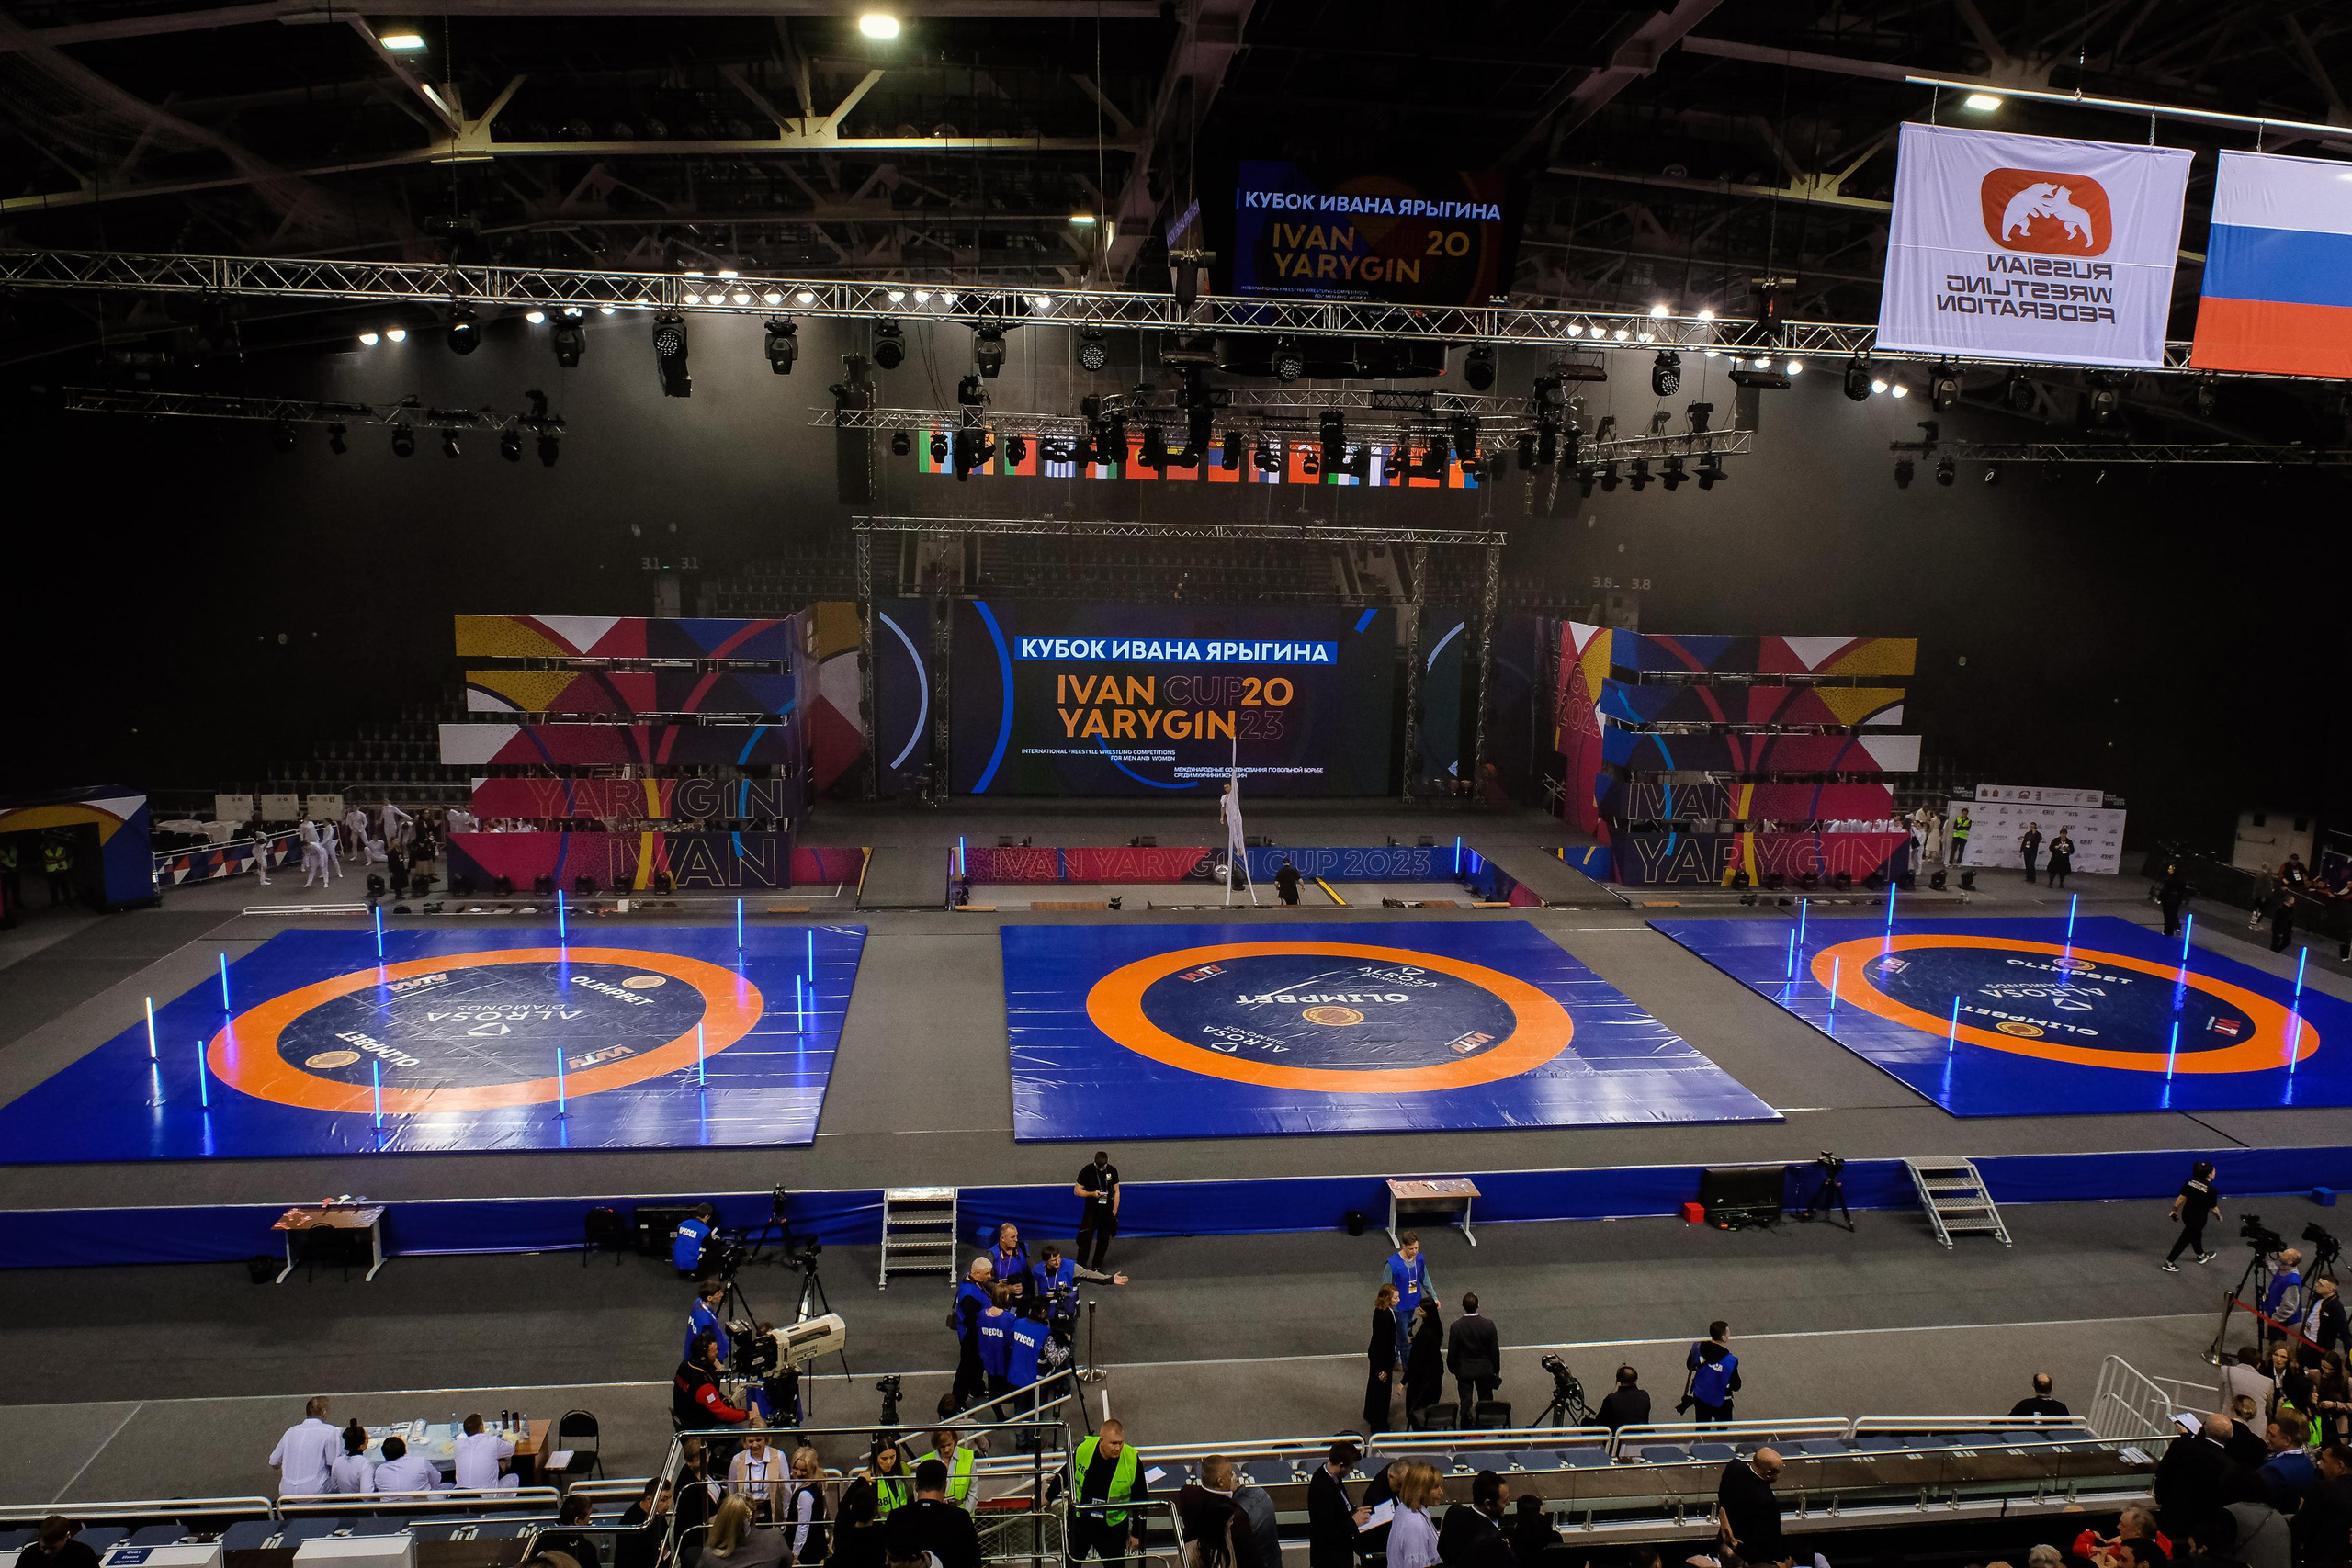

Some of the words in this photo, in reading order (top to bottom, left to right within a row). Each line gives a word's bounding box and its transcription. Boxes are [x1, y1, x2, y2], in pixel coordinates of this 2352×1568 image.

[1245, 191, 1315, 211] КУБОК
[1320, 195, 1394, 215] ИВАНА
[1398, 198, 1501, 220] ЯРЫГИНА
[1272, 222, 1354, 252] IVAN
[1425, 231, 1470, 257] 20
[1273, 253, 1420, 284] YARYGIN
[641, 557, 661, 570] 3.1
[680, 557, 699, 570] 3.1
[1592, 576, 1612, 589] 3.8
[1631, 578, 1651, 590] 3.8
[1022, 638, 1106, 660] КУБОК
[1111, 640, 1201, 660] ИВАНА
[1205, 641, 1329, 662] ЯРЫГИНА
[1057, 674, 1156, 705] IVAN
[1162, 675, 1244, 706] CUP
[1240, 677, 1294, 706] 20
[1057, 708, 1236, 739] YARYGIN
[1239, 709, 1284, 740] 23
[526, 778, 783, 818] YARYGIN
[1627, 784, 1742, 820] IVAN
[609, 839, 776, 886] IVAN
[992, 851, 1083, 878] IVAN
[1263, 850, 1339, 877] CUP
[1343, 850, 1431, 877] 2023
[1634, 838, 1893, 883] YARYGIN
[1357, 965, 1439, 989] ALROSA
[2007, 958, 2133, 986] OLIMPBET
[570, 975, 655, 1008] OLIMPBET
[1236, 993, 1410, 1006] OLIMPBET
[1978, 986, 2107, 998] ALROSA
[425, 1010, 584, 1023] ALROSA
[455, 1003, 567, 1012] DIAMONDS
[1960, 1004, 2099, 1036] OLIMPBET
[334, 1030, 421, 1069] OLIMPBET
[1202, 1024, 1291, 1054] ALROSA
[1013, 1331, 1035, 1348] ПРЕССА
